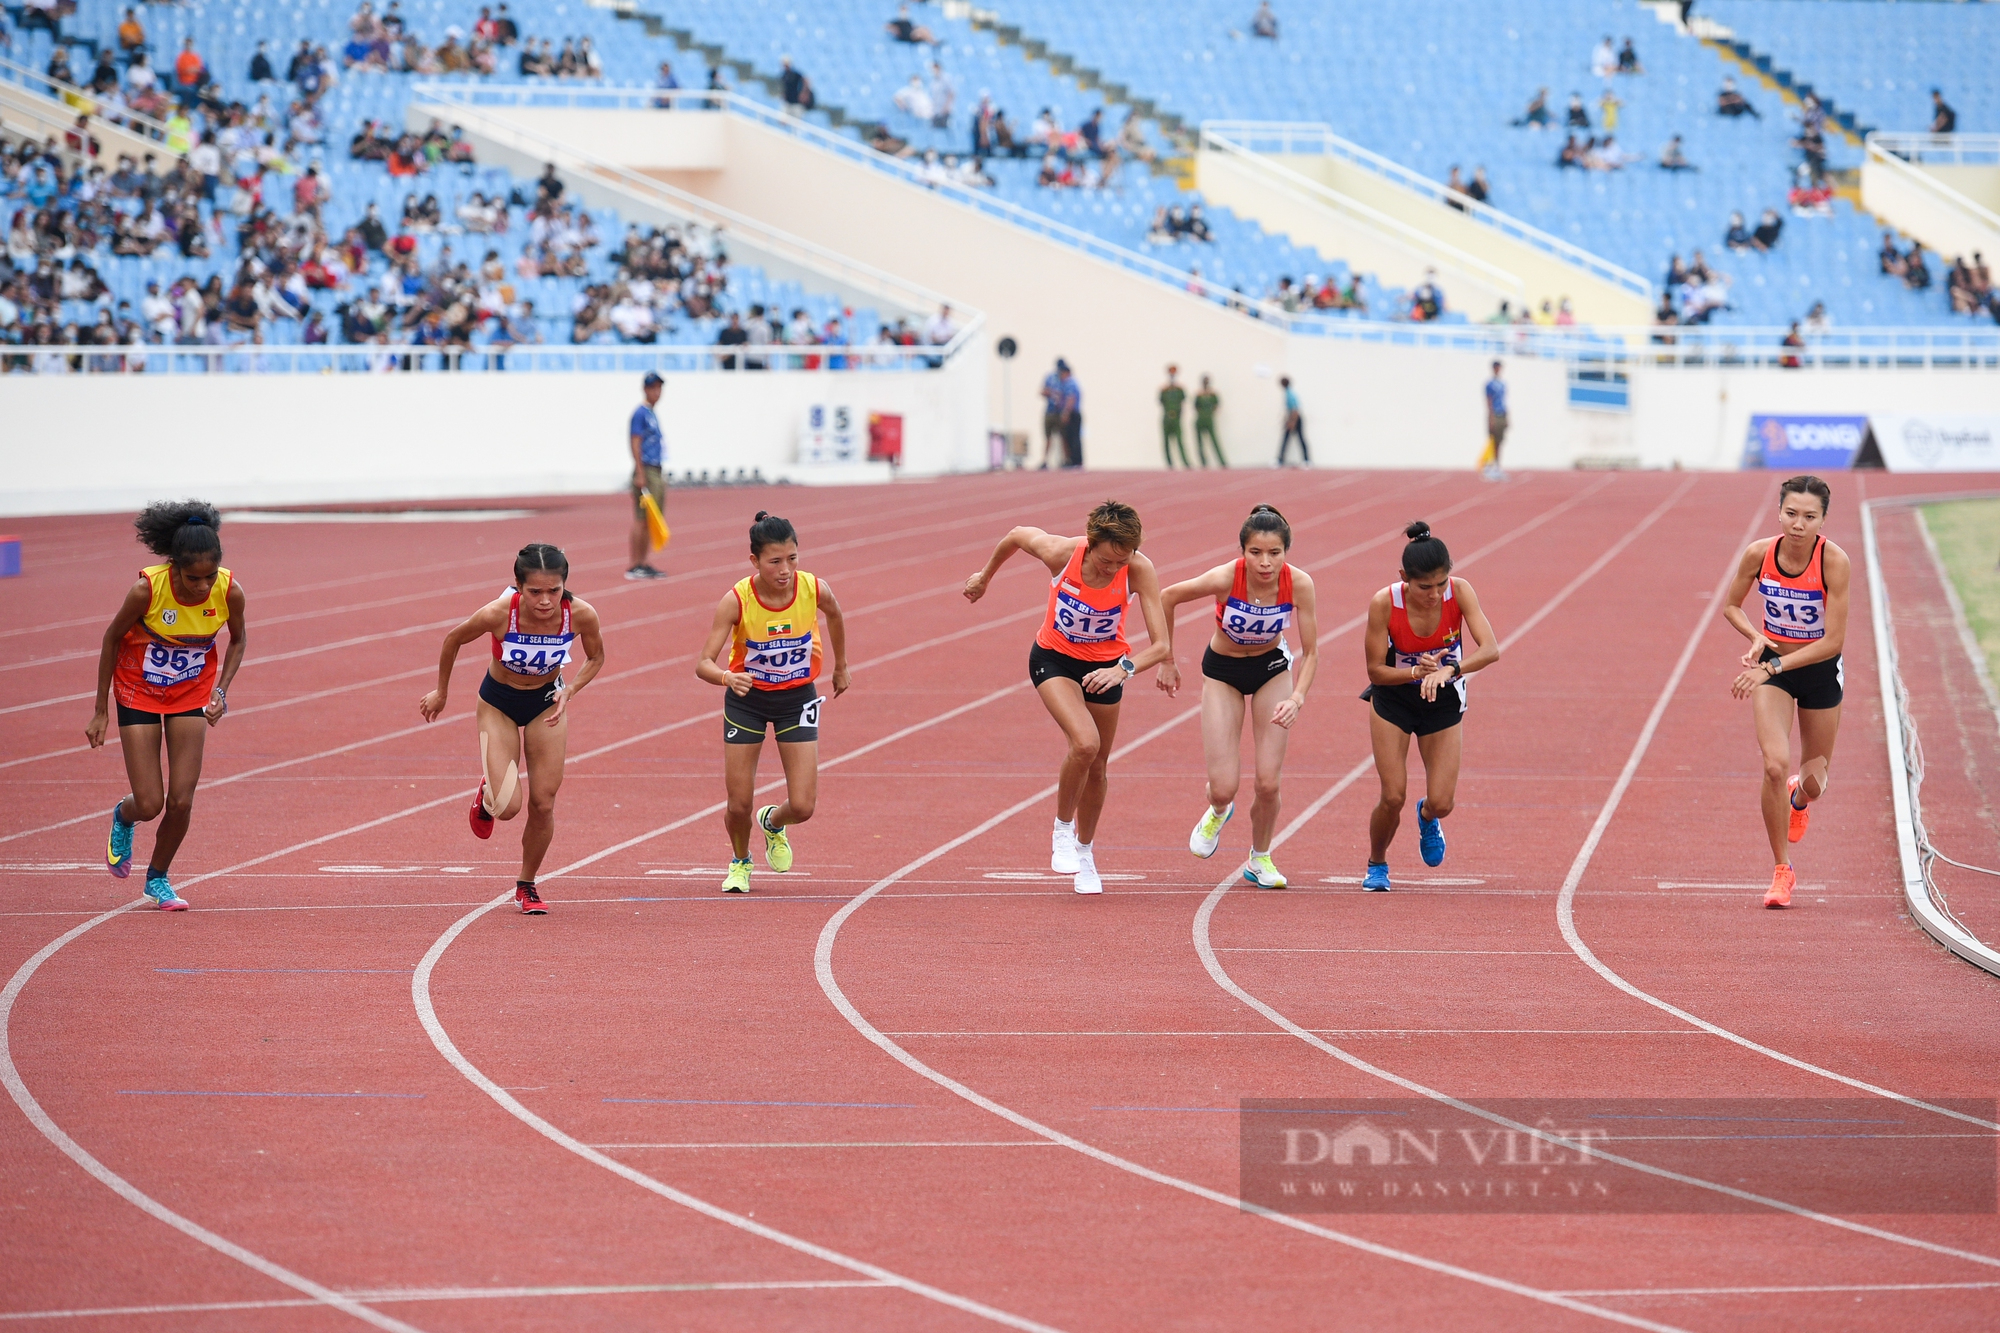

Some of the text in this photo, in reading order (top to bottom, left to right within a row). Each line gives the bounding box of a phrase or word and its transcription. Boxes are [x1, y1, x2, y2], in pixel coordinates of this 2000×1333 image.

[1778, 588, 1789, 596] SEA
[1790, 591, 1809, 599] Games
[1078, 603, 1089, 614] SEA
[1250, 605, 1261, 614] SEA
[1262, 606, 1281, 614] Games
[1766, 600, 1819, 624] 613
[1059, 608, 1114, 633] 612
[1228, 614, 1284, 635] 844
[782, 639, 802, 647] Games
[510, 649, 566, 670] 842
